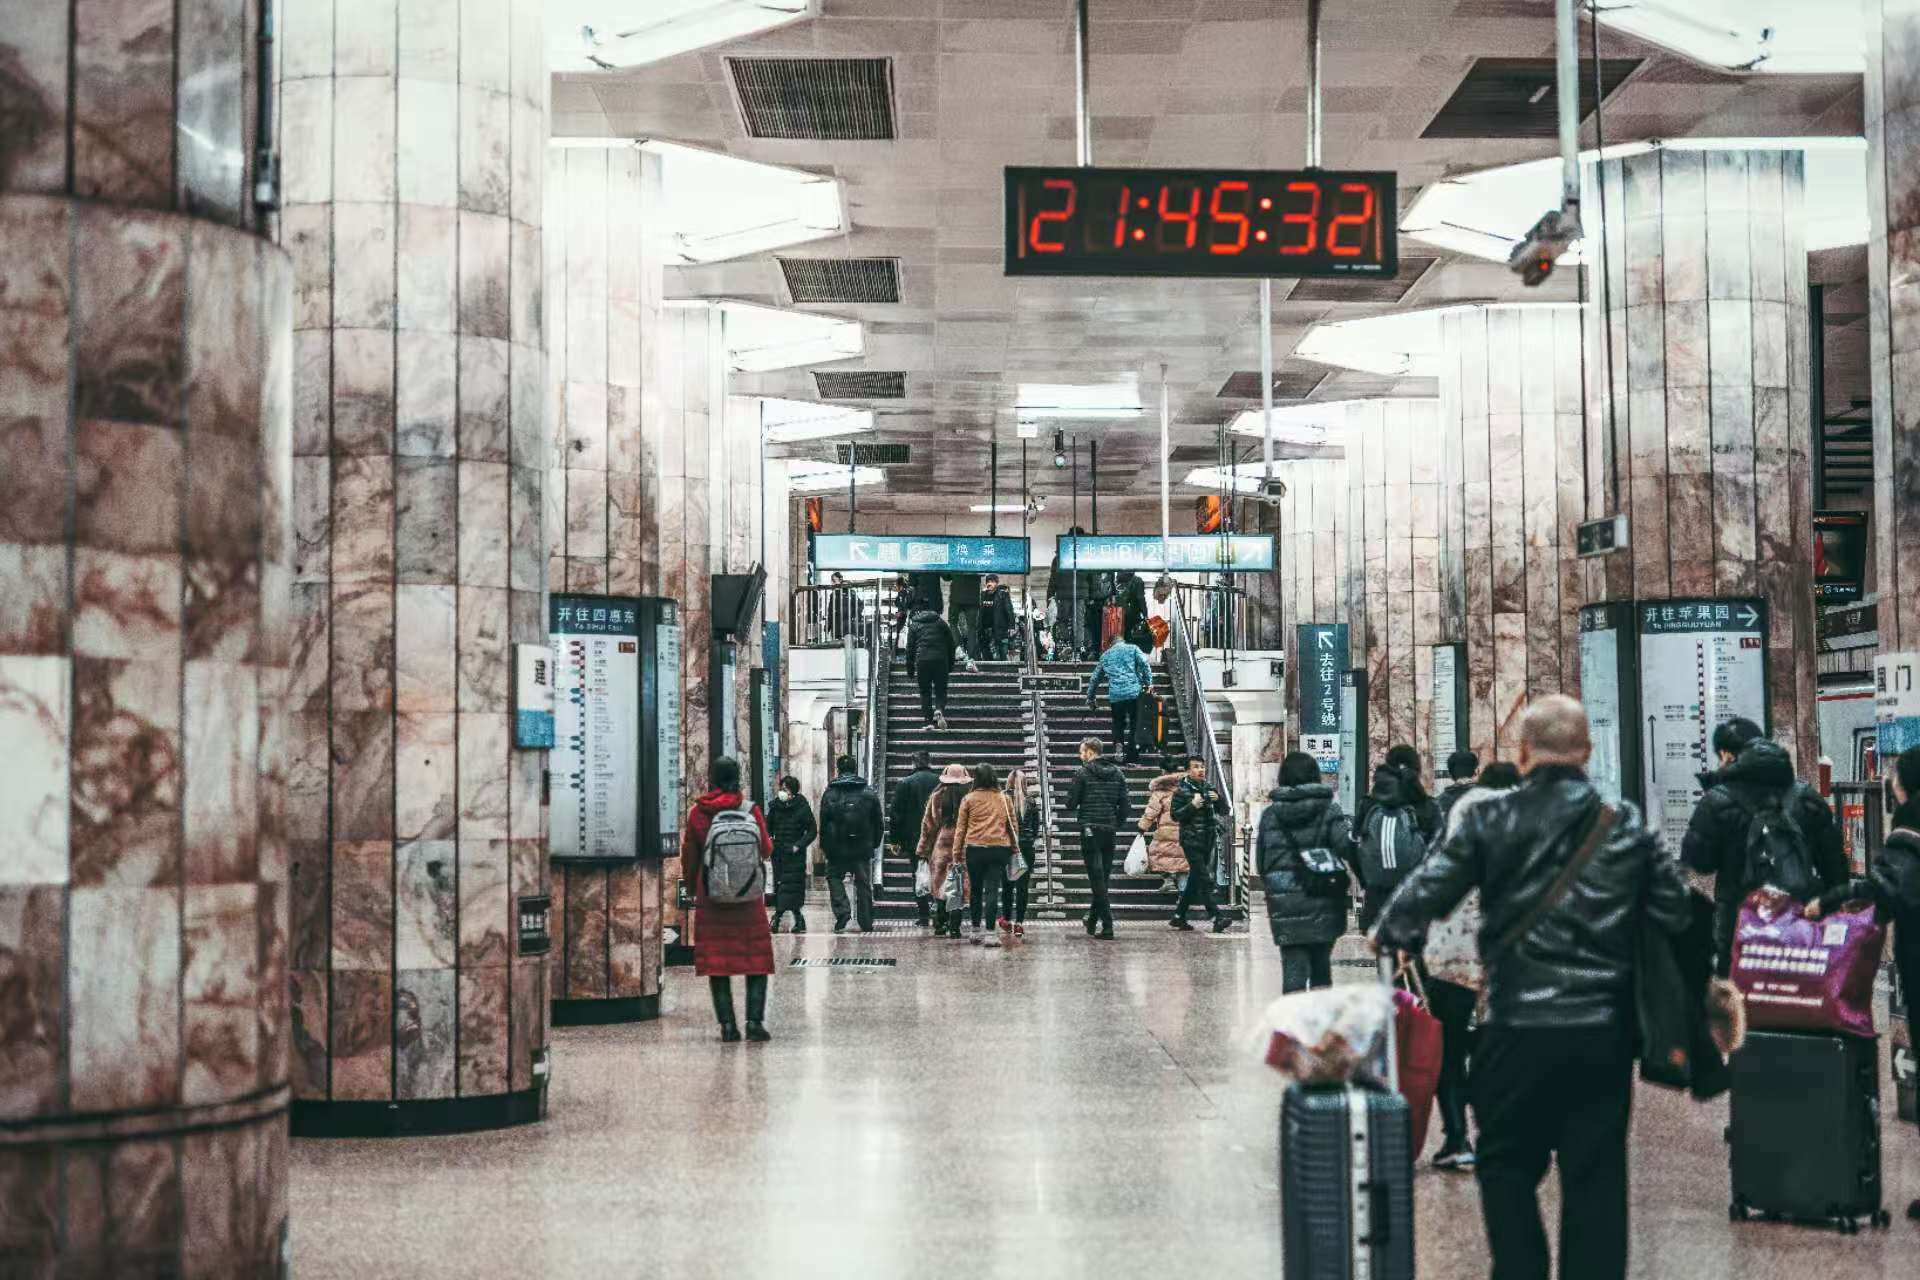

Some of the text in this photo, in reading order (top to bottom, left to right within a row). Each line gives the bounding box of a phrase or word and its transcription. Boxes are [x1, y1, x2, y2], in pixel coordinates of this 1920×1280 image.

[1030, 180, 1374, 257] 21:45:32
[1646, 605, 1729, 622] 开往苹果园
[1319, 653, 1337, 727] 去往2号线
